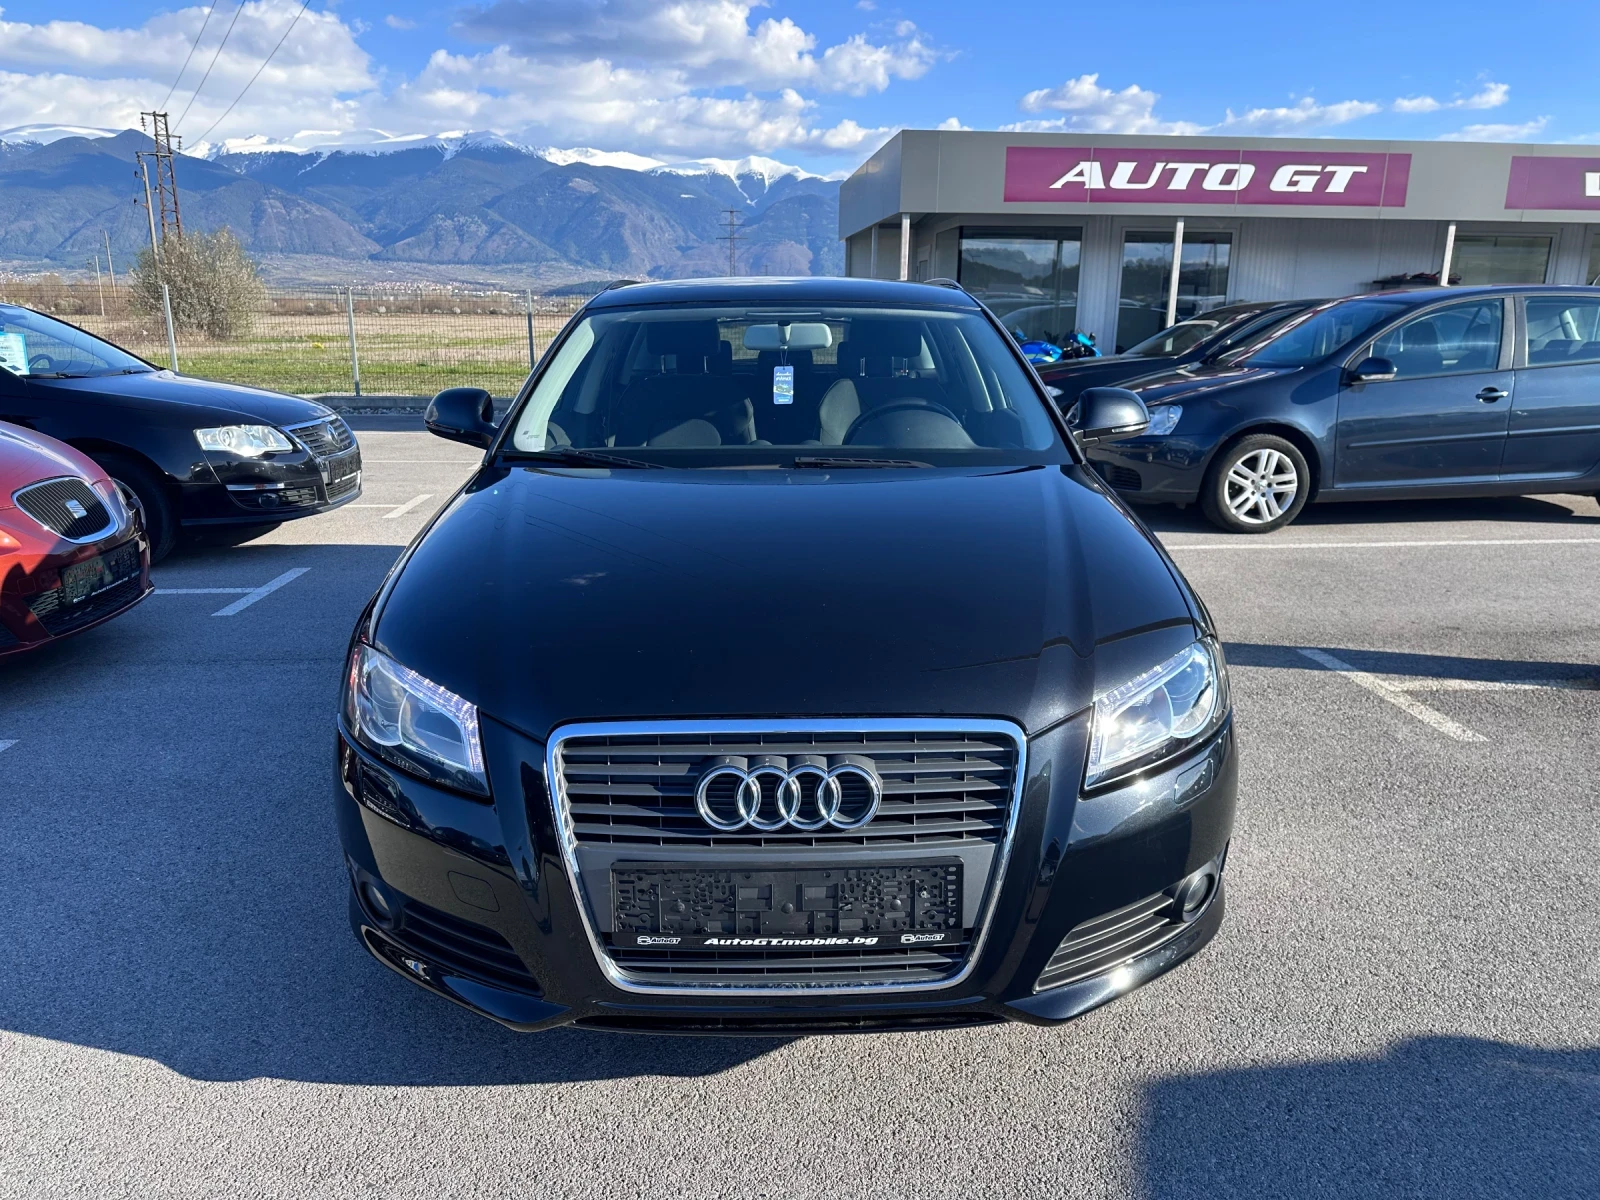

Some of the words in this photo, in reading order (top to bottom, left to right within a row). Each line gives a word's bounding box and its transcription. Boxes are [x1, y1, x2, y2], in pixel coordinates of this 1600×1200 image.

[1049, 161, 1256, 191] AUTO
[1269, 164, 1368, 193] GT
[704, 937, 879, 946] AutoGT.mobile.bg
